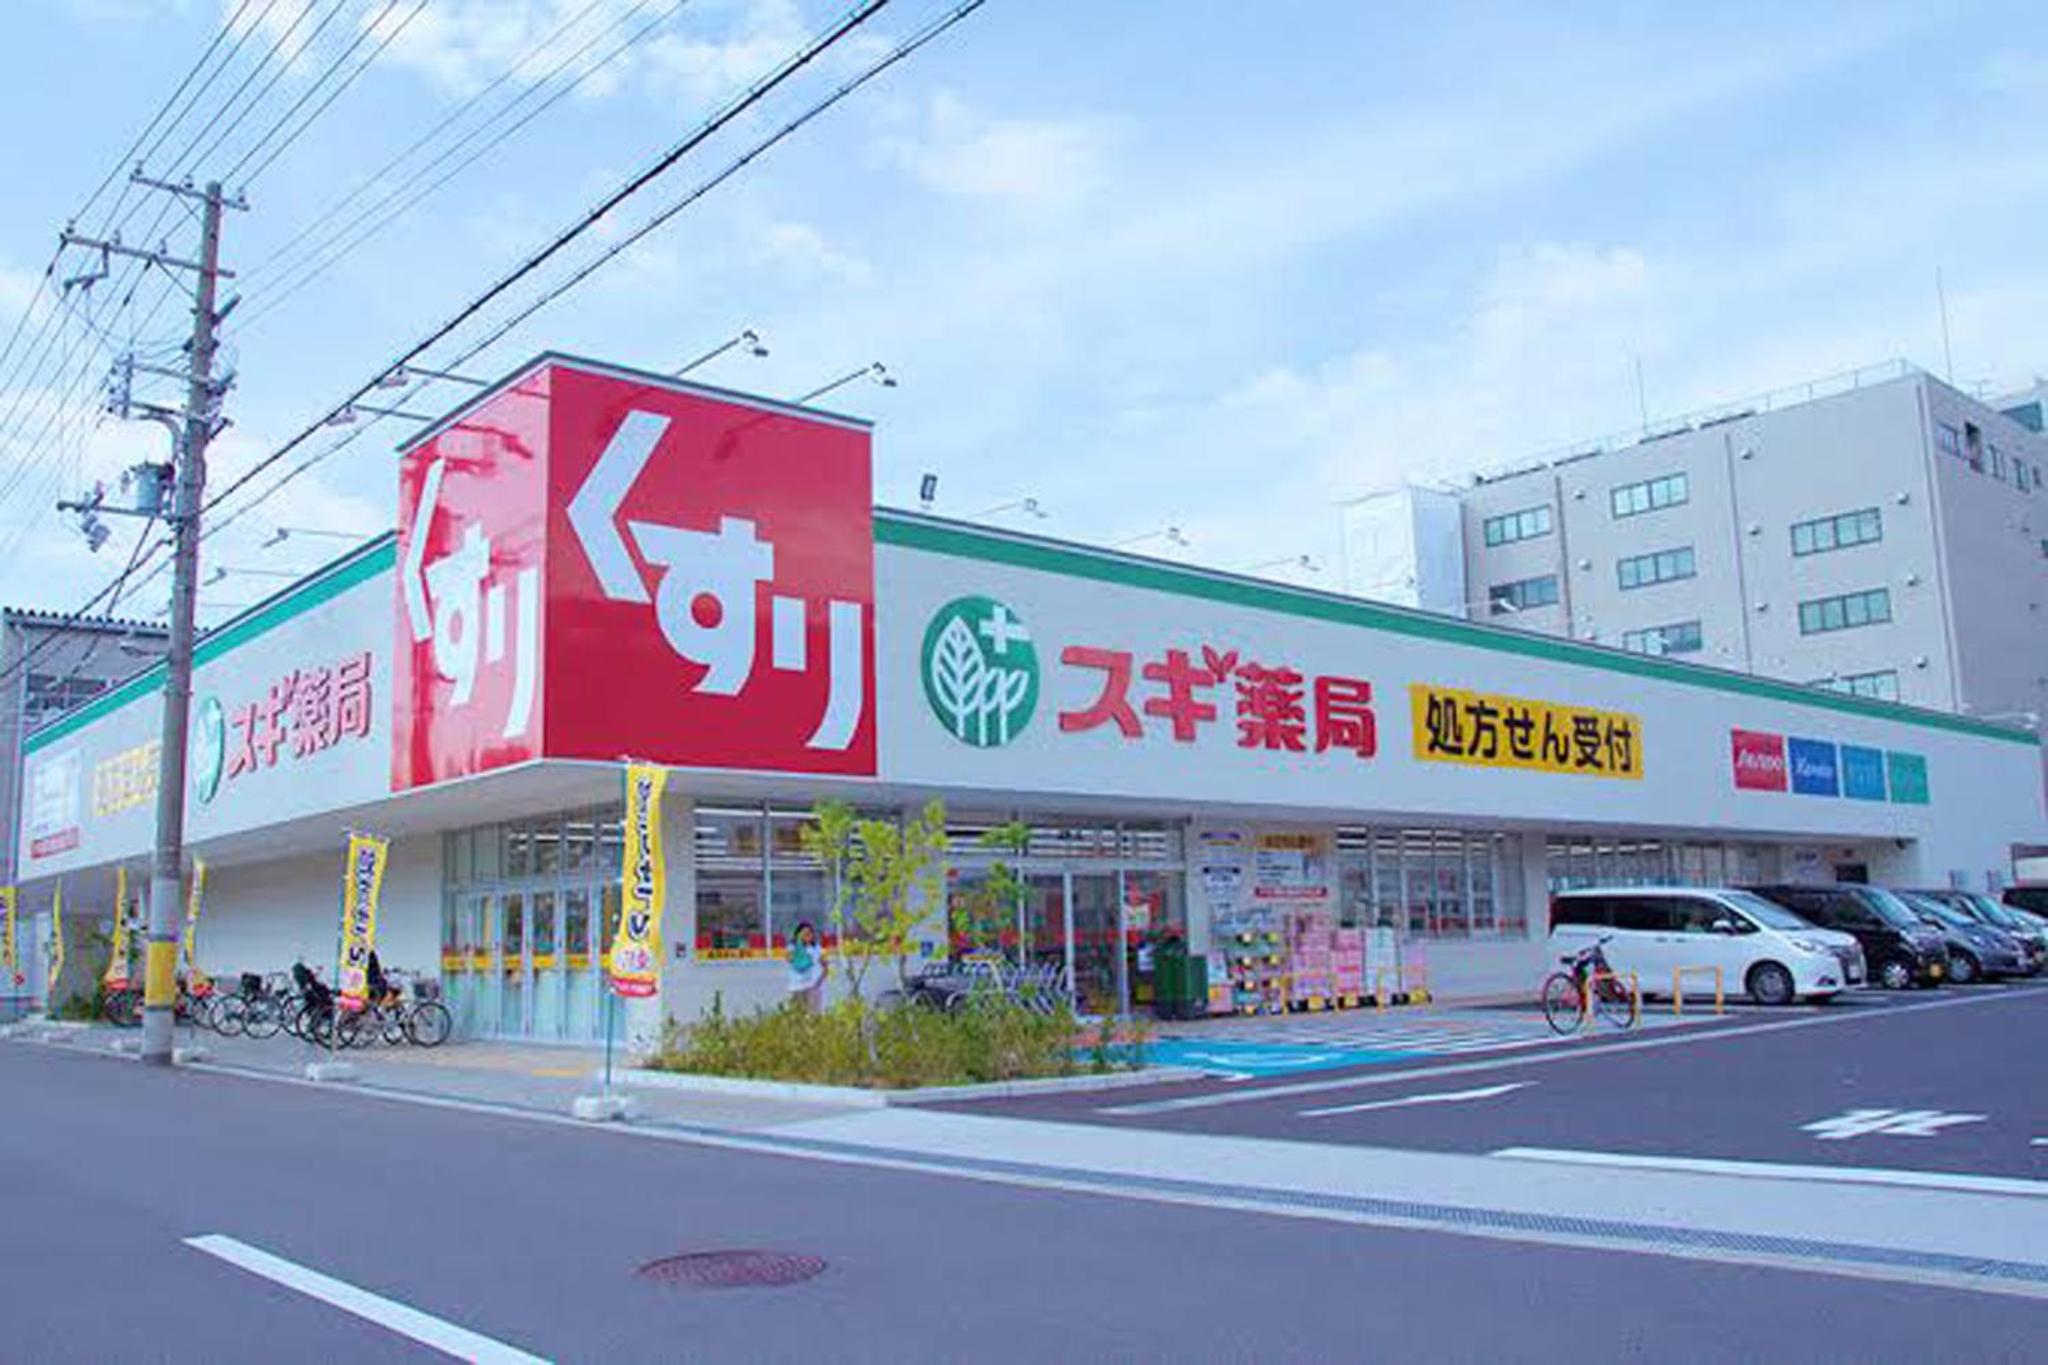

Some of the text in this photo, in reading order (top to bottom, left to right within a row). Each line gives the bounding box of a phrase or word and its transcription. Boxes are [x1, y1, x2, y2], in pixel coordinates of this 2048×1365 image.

[403, 458, 538, 739] くすり
[567, 409, 863, 751] くすり
[227, 652, 372, 779] スギ薬局
[1059, 645, 1376, 759] スギ薬局
[1426, 693, 1632, 772] 処方せん受付
